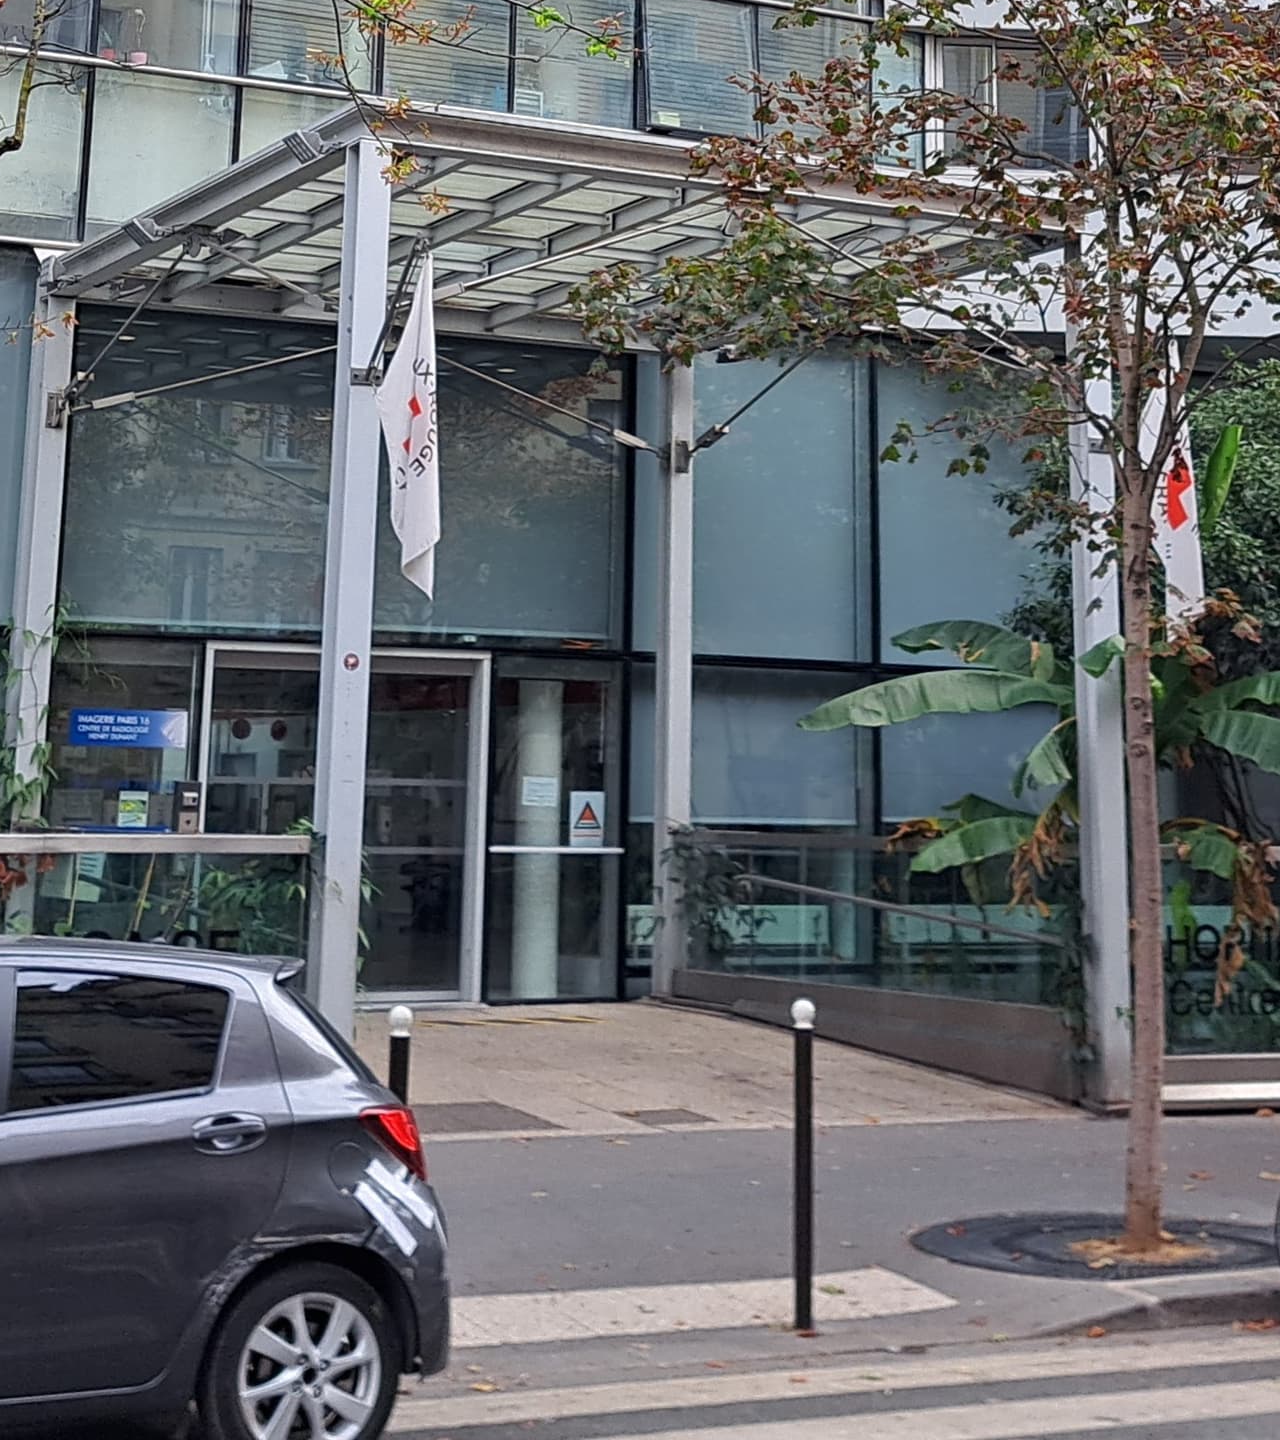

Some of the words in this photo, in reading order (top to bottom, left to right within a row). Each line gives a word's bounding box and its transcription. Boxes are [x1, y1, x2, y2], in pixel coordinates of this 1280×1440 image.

[78, 714, 114, 725] IMAGERIE
[117, 715, 138, 725] PARIS
[140, 716, 151, 725] 16
[77, 724, 101, 733] CENTRE
[102, 725, 111, 733] DE
[112, 725, 149, 734] RADIOLOGIE
[110, 733, 138, 741] DUNANT
